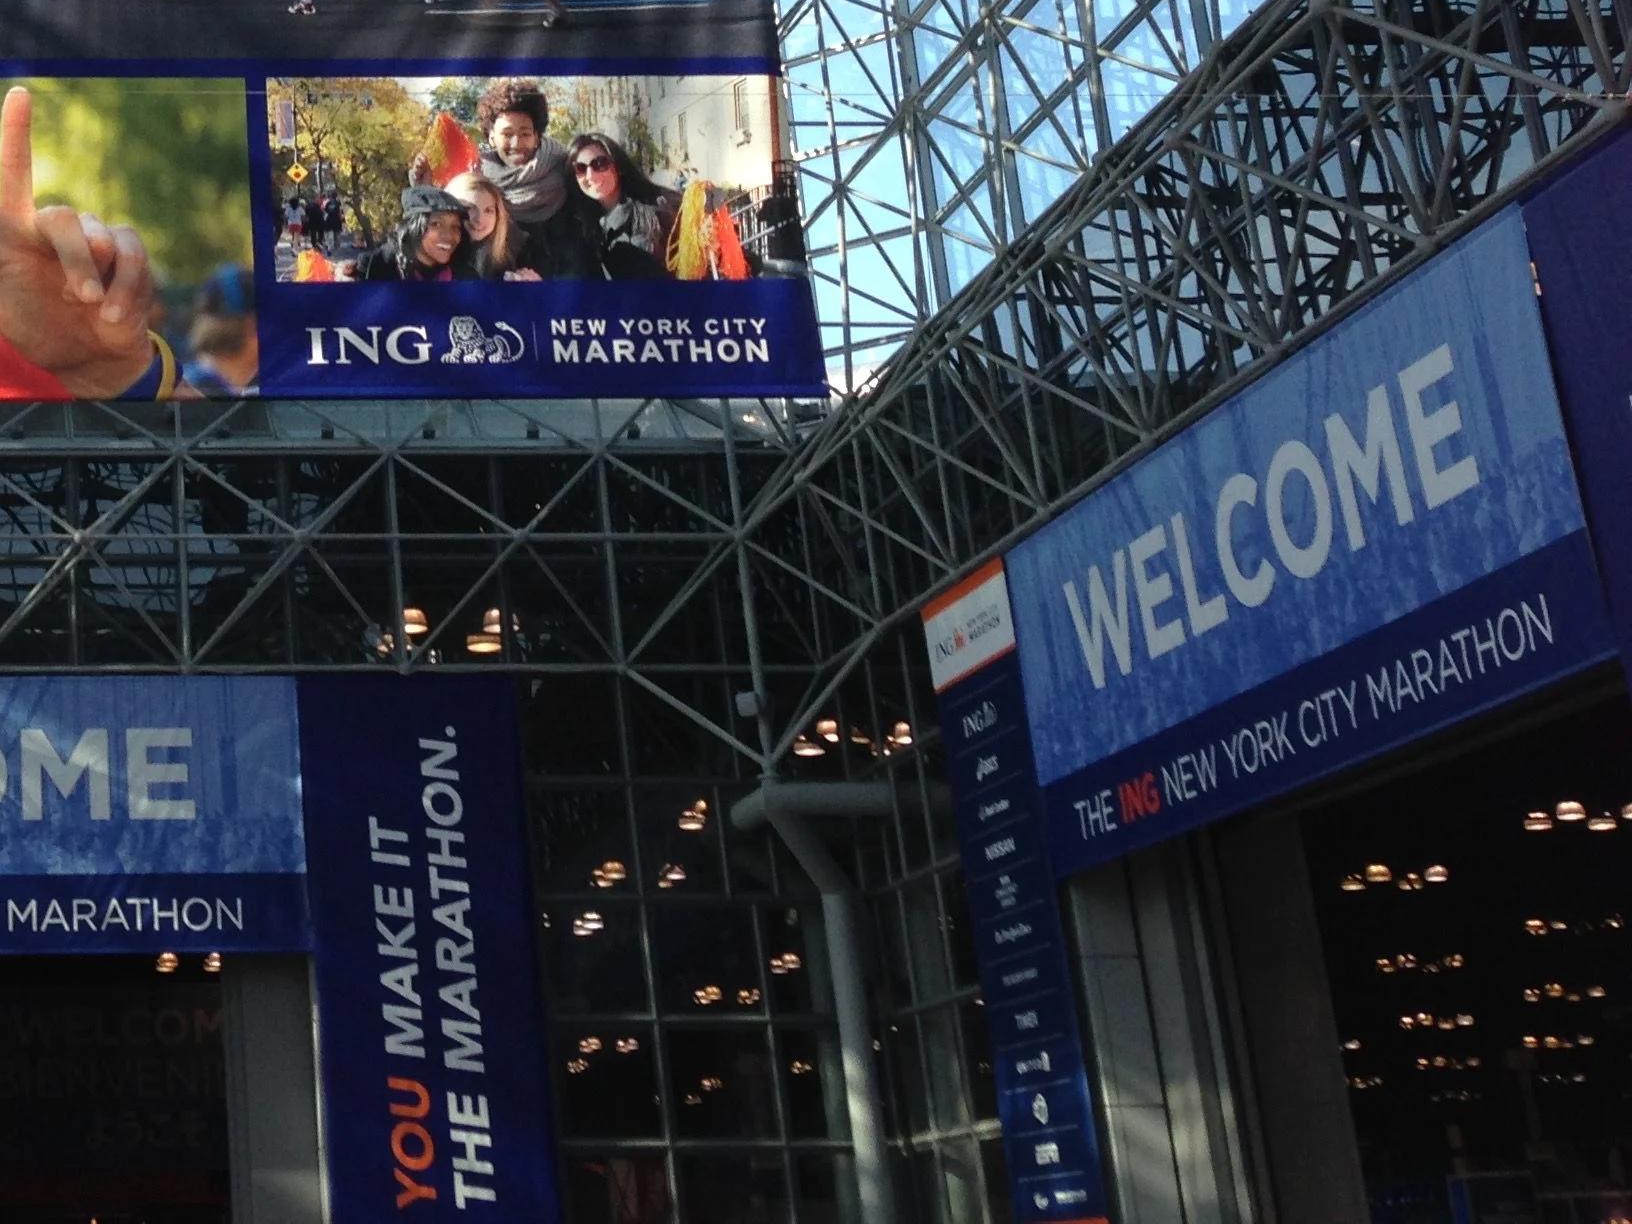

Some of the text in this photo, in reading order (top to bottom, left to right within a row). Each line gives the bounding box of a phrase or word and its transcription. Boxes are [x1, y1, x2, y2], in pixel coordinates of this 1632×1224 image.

[305, 325, 433, 365] ING
[550, 318, 767, 337] NEW YORK CITY
[553, 338, 770, 364] MARATHON
[1063, 343, 1481, 690] WELCOME
[1074, 593, 1554, 840] THE ING NEW YORK CITY MARATHON
[7, 896, 244, 933] MARATHON
[418, 725, 497, 1210] THE MARATHON.
[11, 1006, 224, 1046] WELCOM
[369, 816, 438, 1210] YOU MAKE IT
